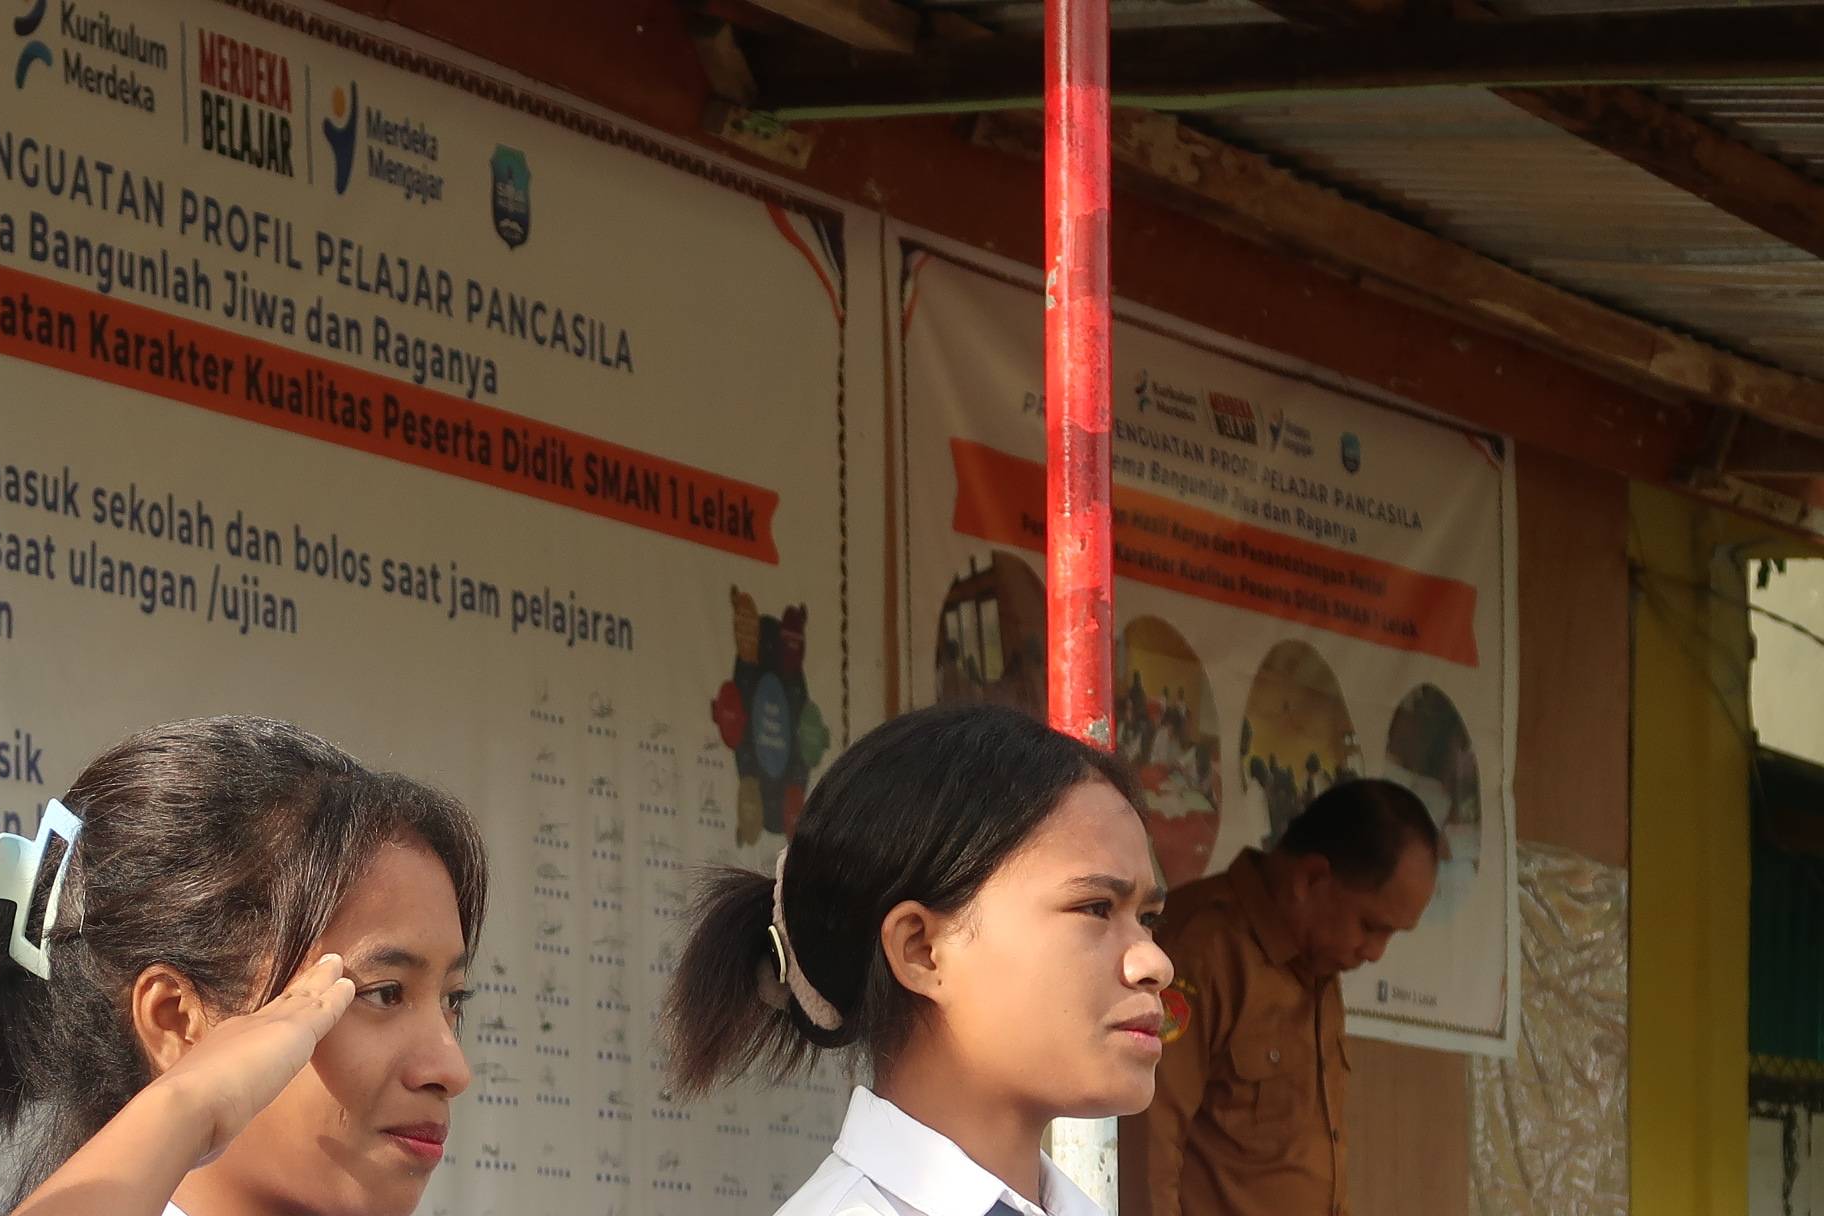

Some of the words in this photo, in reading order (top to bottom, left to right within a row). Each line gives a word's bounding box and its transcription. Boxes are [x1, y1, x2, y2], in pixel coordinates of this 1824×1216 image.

[60, 0, 167, 71] Kurikulum
[63, 48, 155, 113] Merdeka
[198, 28, 293, 114] MERDEKA
[200, 88, 295, 179] BELAJAR
[29, 211, 211, 311] Bangunlah
[223, 269, 297, 336] Jiwa
[307, 295, 363, 355] dan
[374, 315, 498, 399] Raganya
[180, 188, 304, 270] PROFIL
[316, 231, 454, 318] PELAJAR
[466, 277, 634, 374] PANCASILA
[89, 310, 235, 395] Karakter
[244, 354, 373, 434] Kualitas
[383, 393, 493, 466] Peserta
[502, 427, 575, 491] Didik
[584, 454, 662, 518] SMAN
[667, 476, 681, 521] 1
[688, 481, 757, 543] Lelak
[1113, 453, 1145, 479] ema
[1264, 498, 1292, 526] dan
[1295, 506, 1358, 545] Raganya
[1114, 418, 1205, 464] ENGUATAN
[1335, 487, 1424, 532] PANCASILA
[69, 540, 196, 615] ulangan
[207, 563, 298, 635] /ujian
[93, 483, 213, 552] sekolah
[226, 510, 281, 567] dan
[295, 524, 370, 590] bolos
[382, 557, 441, 604] saat
[449, 560, 499, 619] jam
[512, 586, 633, 652] pelajaran
